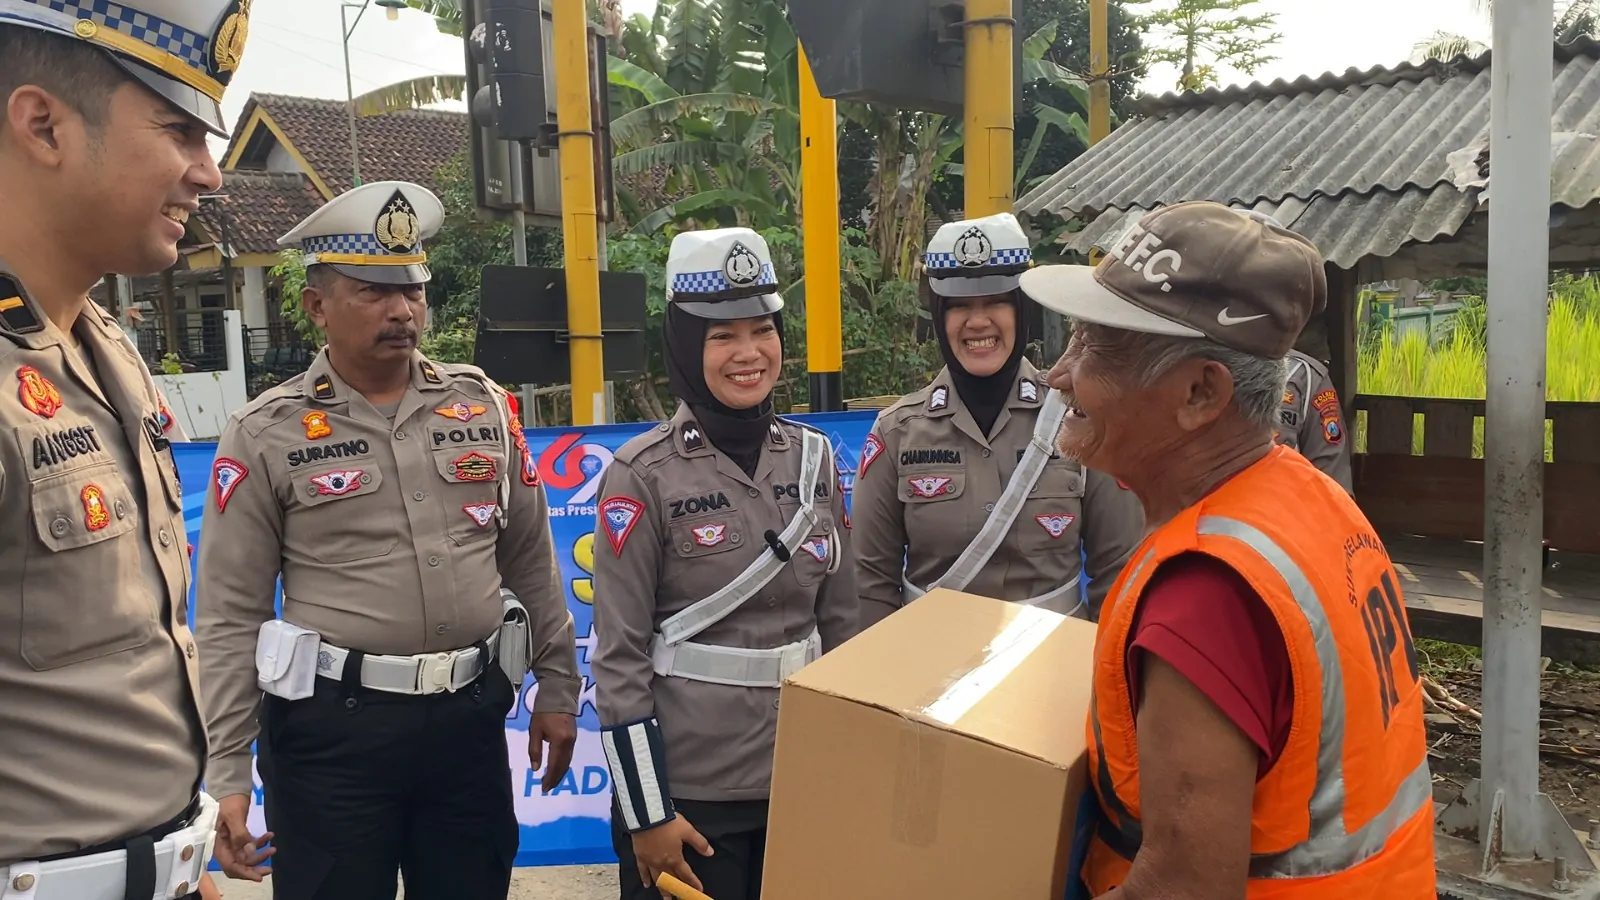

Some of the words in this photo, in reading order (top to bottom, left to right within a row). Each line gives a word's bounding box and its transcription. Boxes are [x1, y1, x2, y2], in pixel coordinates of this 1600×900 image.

[33, 425, 101, 469] ANGGIT
[433, 427, 499, 445] POLRI
[288, 438, 369, 466] SURATNO
[773, 482, 829, 500] PORI
[669, 492, 730, 518] ZONA
[524, 765, 613, 797] HAD
